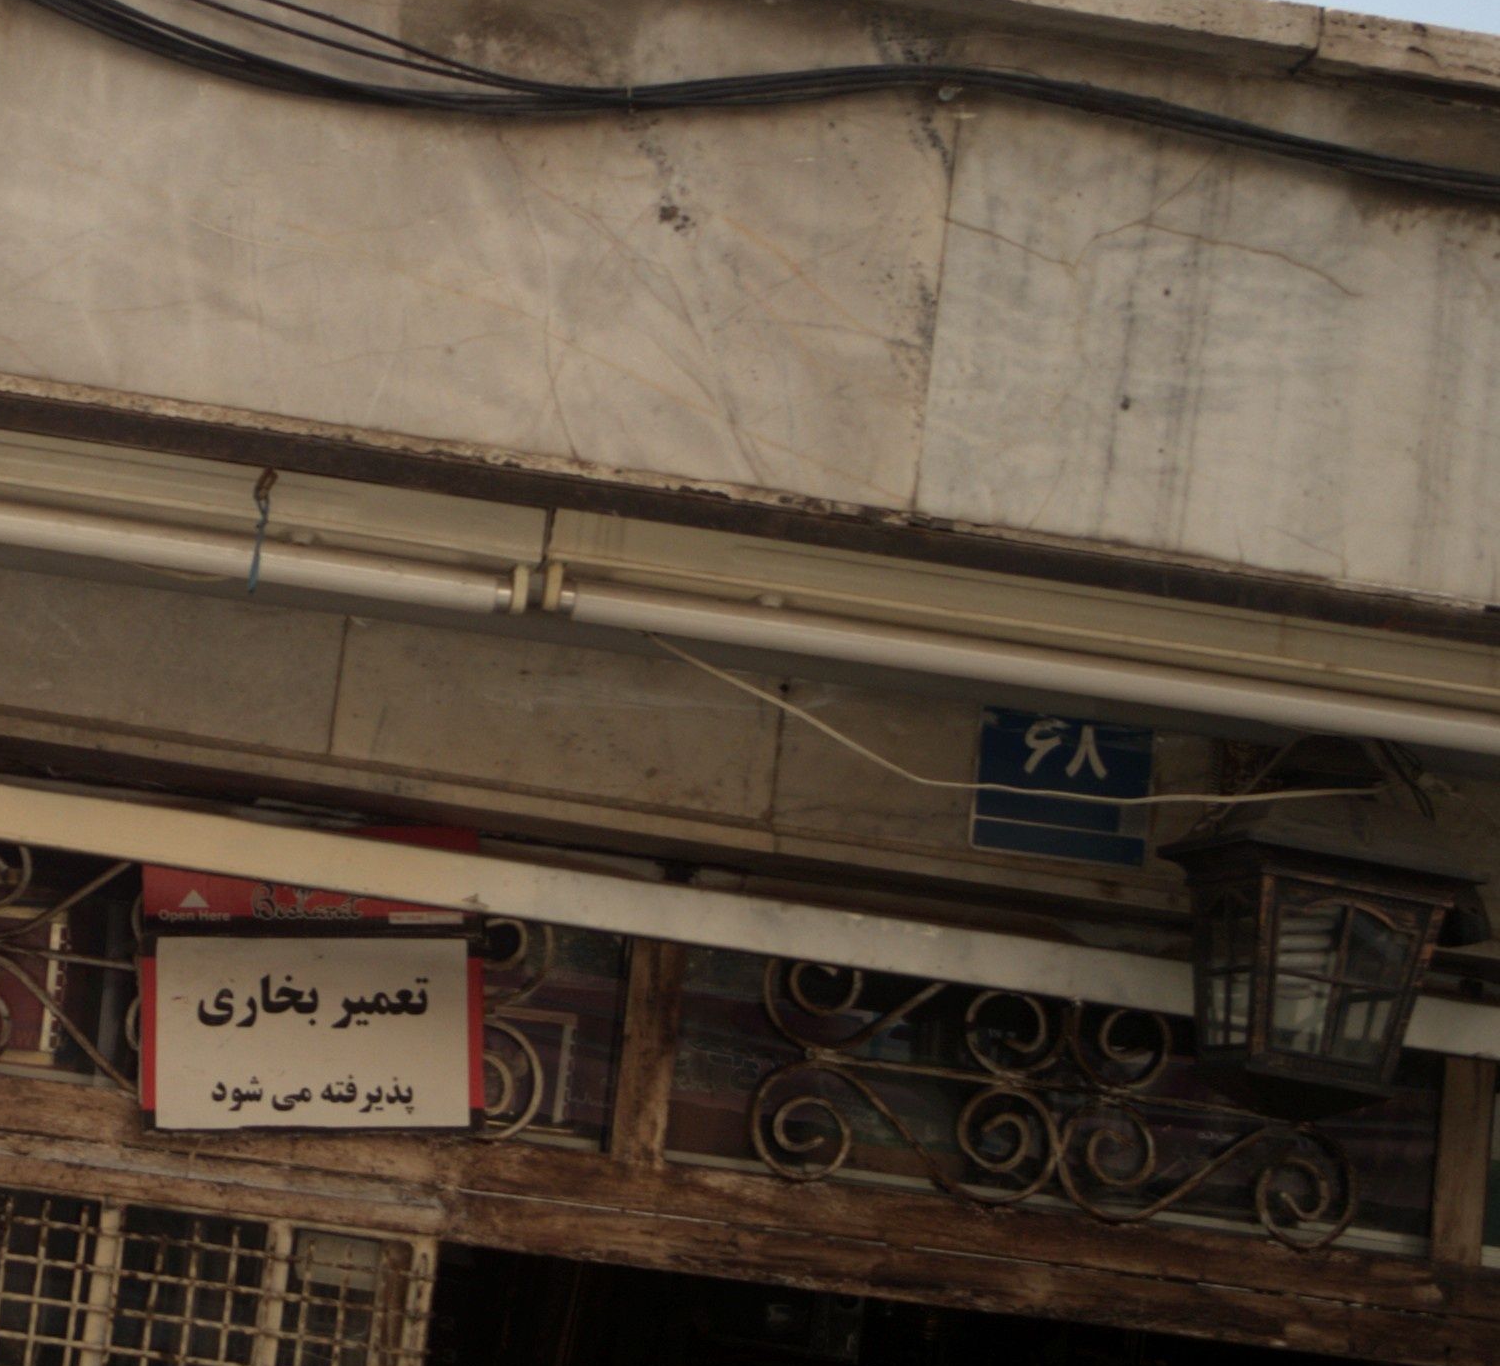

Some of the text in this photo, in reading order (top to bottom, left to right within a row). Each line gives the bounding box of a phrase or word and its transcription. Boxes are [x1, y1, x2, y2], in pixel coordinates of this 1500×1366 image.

[1024, 718, 1108, 778] ۶۸
[158, 909, 231, 923] Open Here
[198, 974, 429, 1028] تعمیر بخاری
[212, 1075, 414, 1113] پذیرفته می شود
